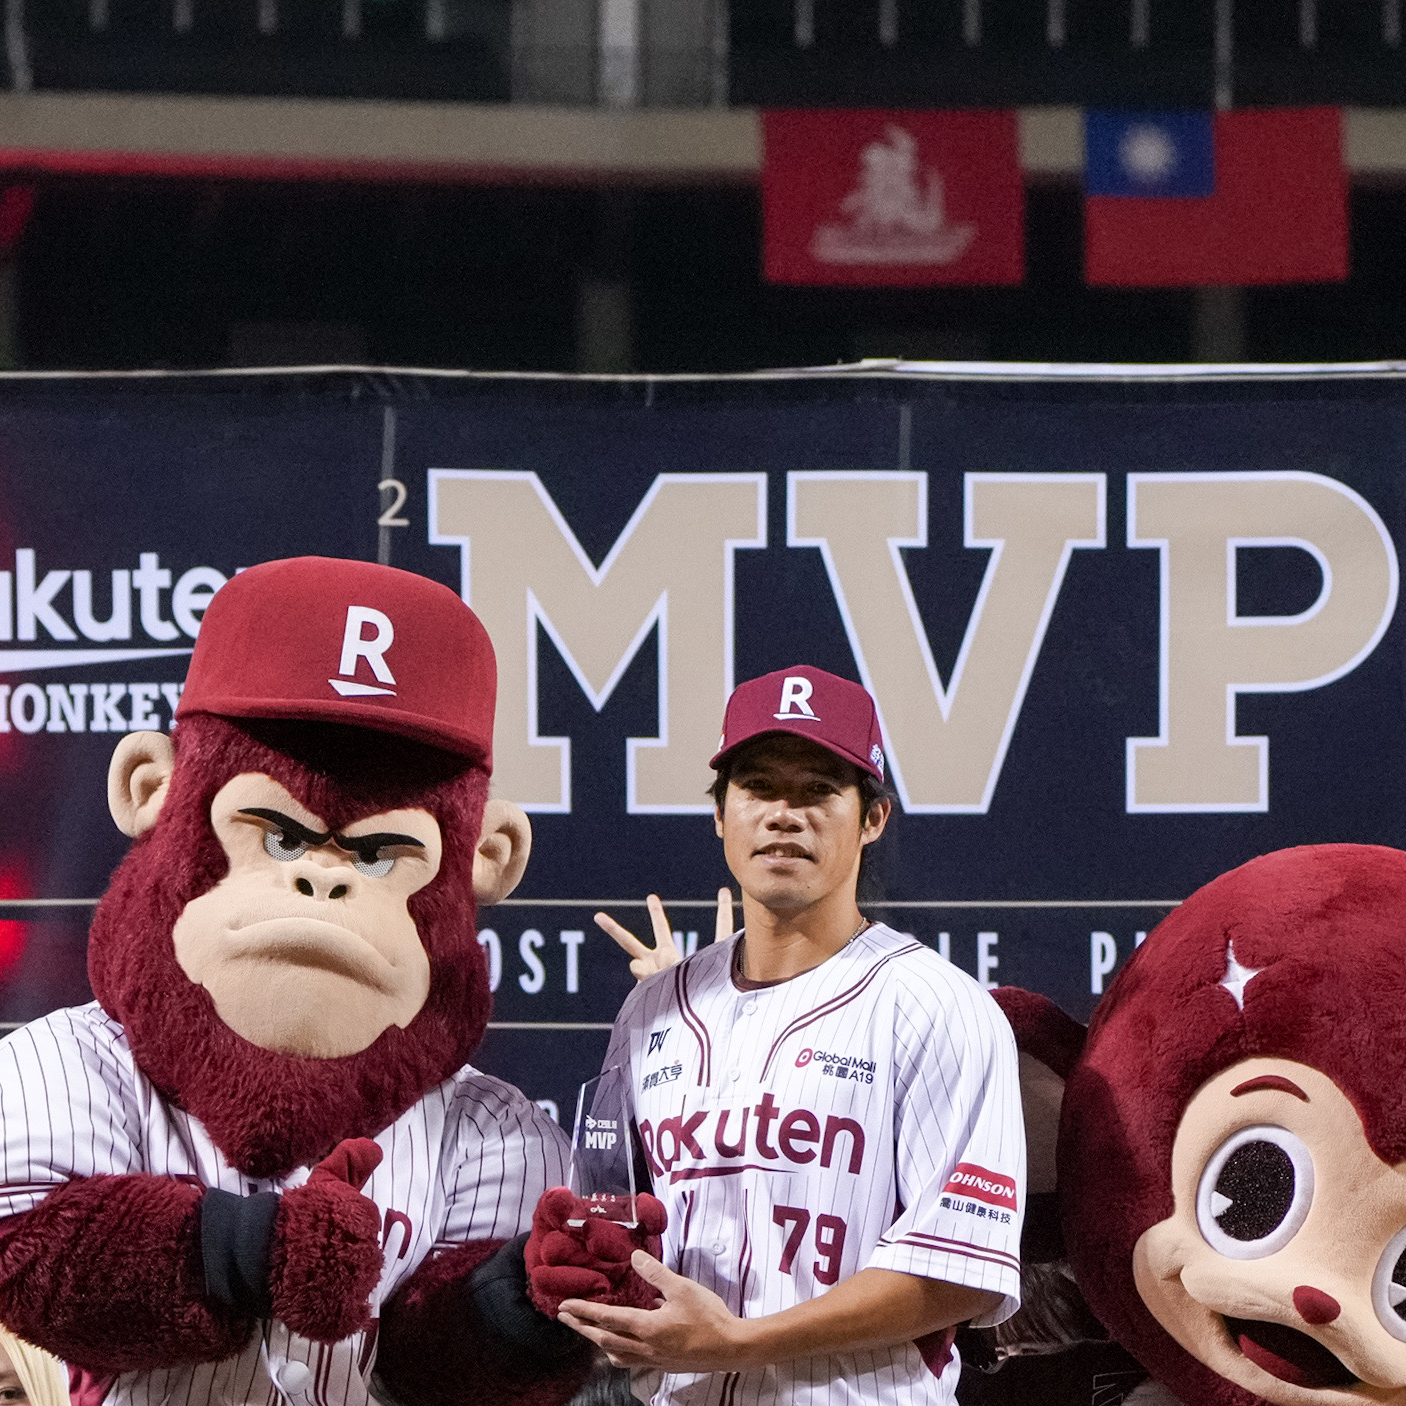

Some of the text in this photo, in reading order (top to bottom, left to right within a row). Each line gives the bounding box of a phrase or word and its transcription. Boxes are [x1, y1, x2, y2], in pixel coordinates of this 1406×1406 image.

[338, 605, 396, 686] R
[427, 468, 1399, 815] MVP
[779, 676, 815, 716] R
[482, 929, 586, 994] OST
[813, 1050, 876, 1074] Global Mall
[585, 1131, 618, 1150] MVP
[639, 1092, 866, 1179] Rakuten
[949, 1171, 1015, 1199] OHNSON
[772, 1204, 848, 1287] 79
